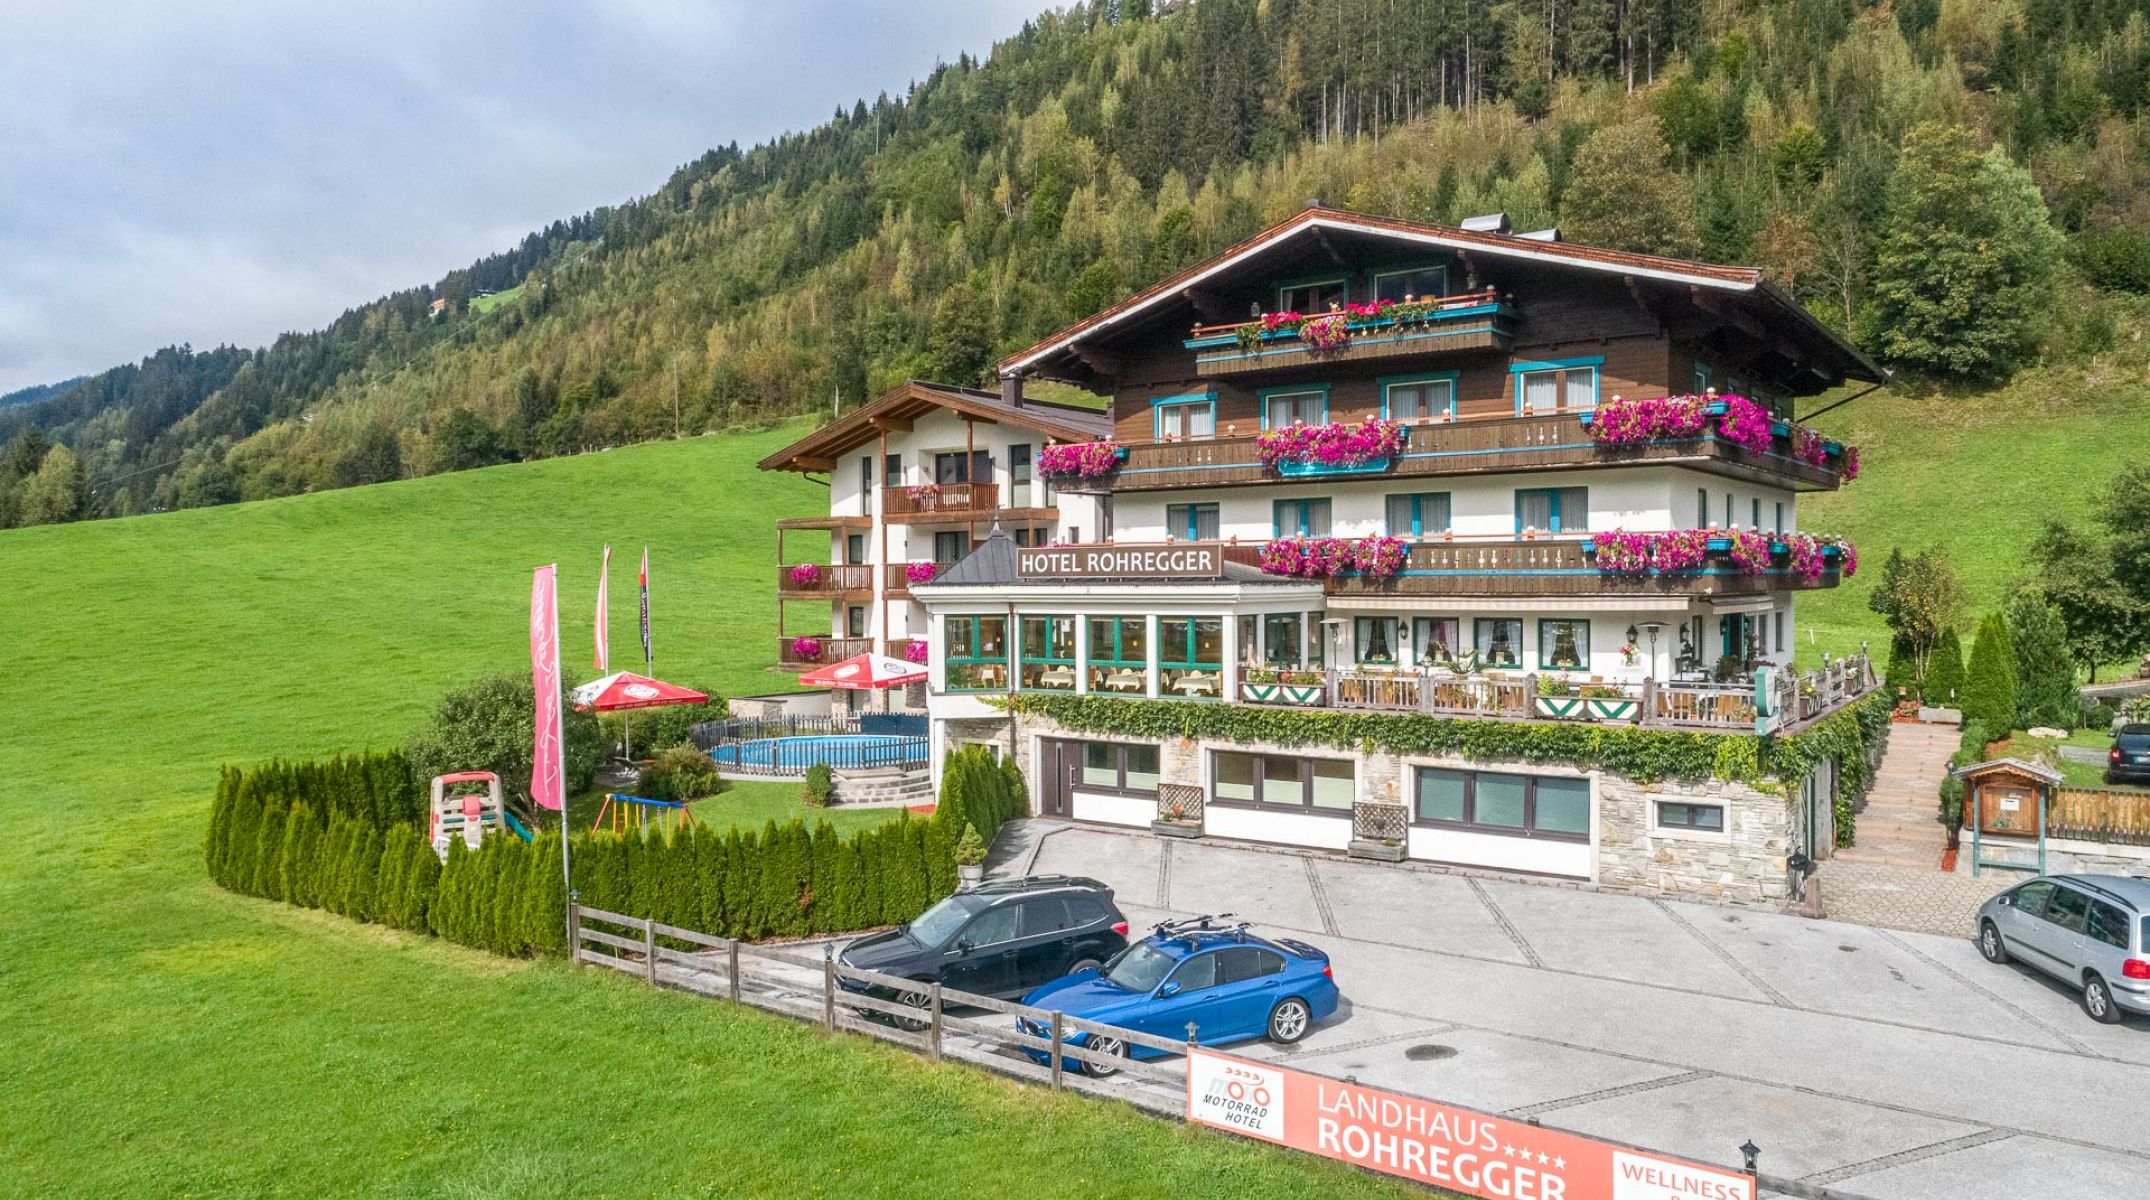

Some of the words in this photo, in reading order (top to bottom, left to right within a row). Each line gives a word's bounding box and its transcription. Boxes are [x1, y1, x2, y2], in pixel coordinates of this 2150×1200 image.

[1022, 553, 1082, 572] HOTEL
[1088, 551, 1212, 572] ROHREGGER
[1202, 1094, 1268, 1118] MOTORRAD
[1225, 1111, 1262, 1130] HOTEL
[1318, 1083, 1498, 1152] LANDHAUS
[1318, 1117, 1567, 1200] ROHREGGER
[1622, 1162, 1741, 1200] WELLNESS
